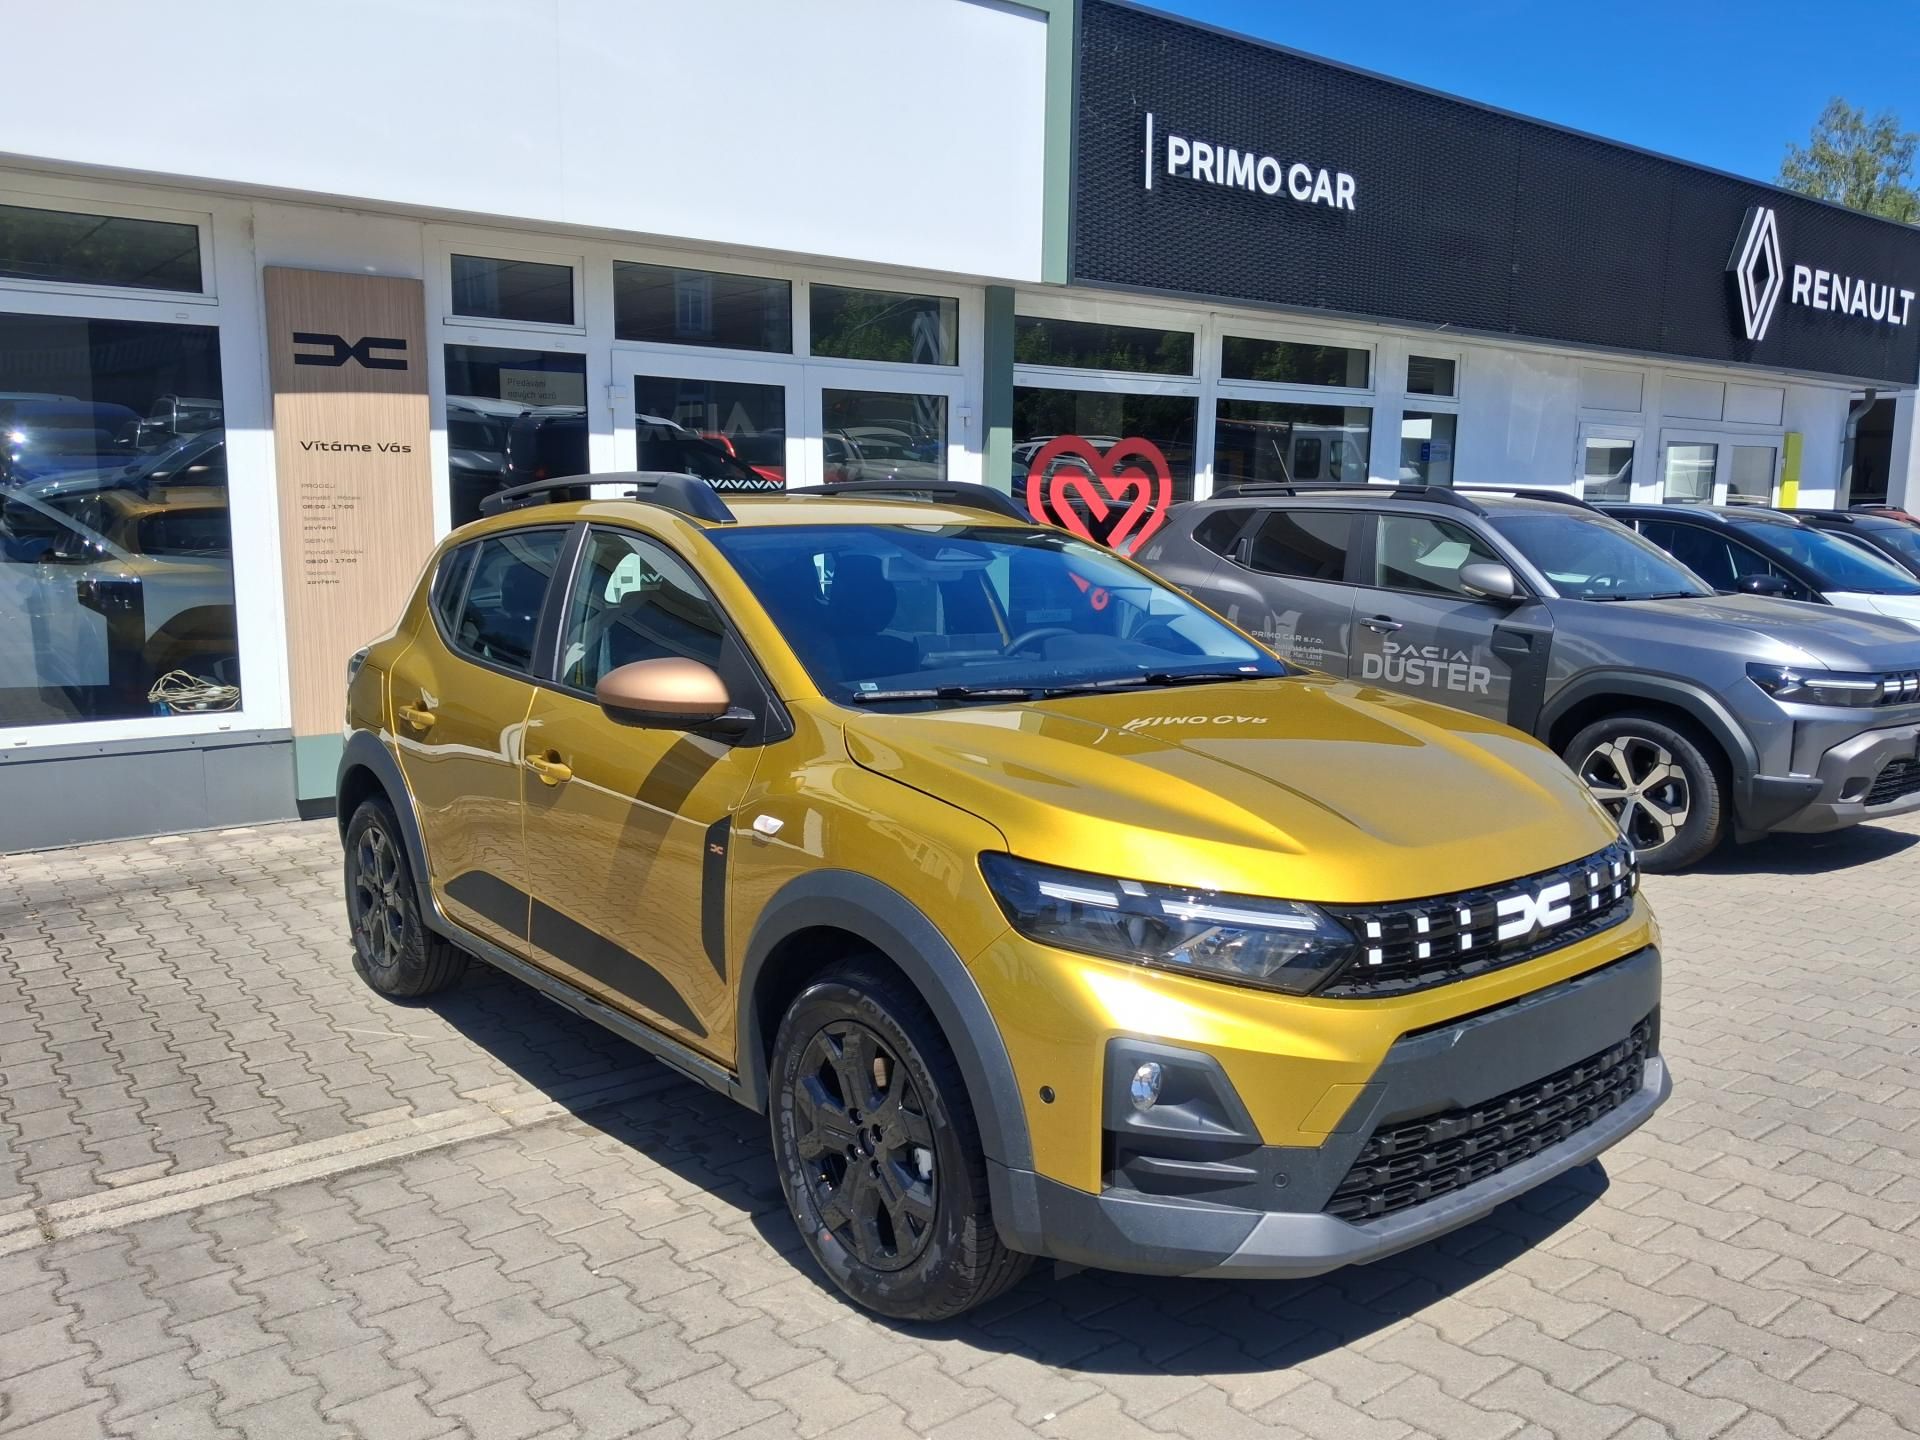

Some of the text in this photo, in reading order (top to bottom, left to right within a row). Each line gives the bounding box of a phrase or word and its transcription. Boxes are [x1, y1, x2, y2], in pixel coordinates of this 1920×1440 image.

[1168, 135, 1355, 210] PRIMO CAR
[1791, 264, 1916, 326] RENAULT
[300, 440, 412, 453] Vítáme Vás
[1251, 630, 1325, 645] PRIMO CAR s.r.o.
[1382, 641, 1470, 662] DACIA
[1362, 653, 1492, 695] DUSTER
